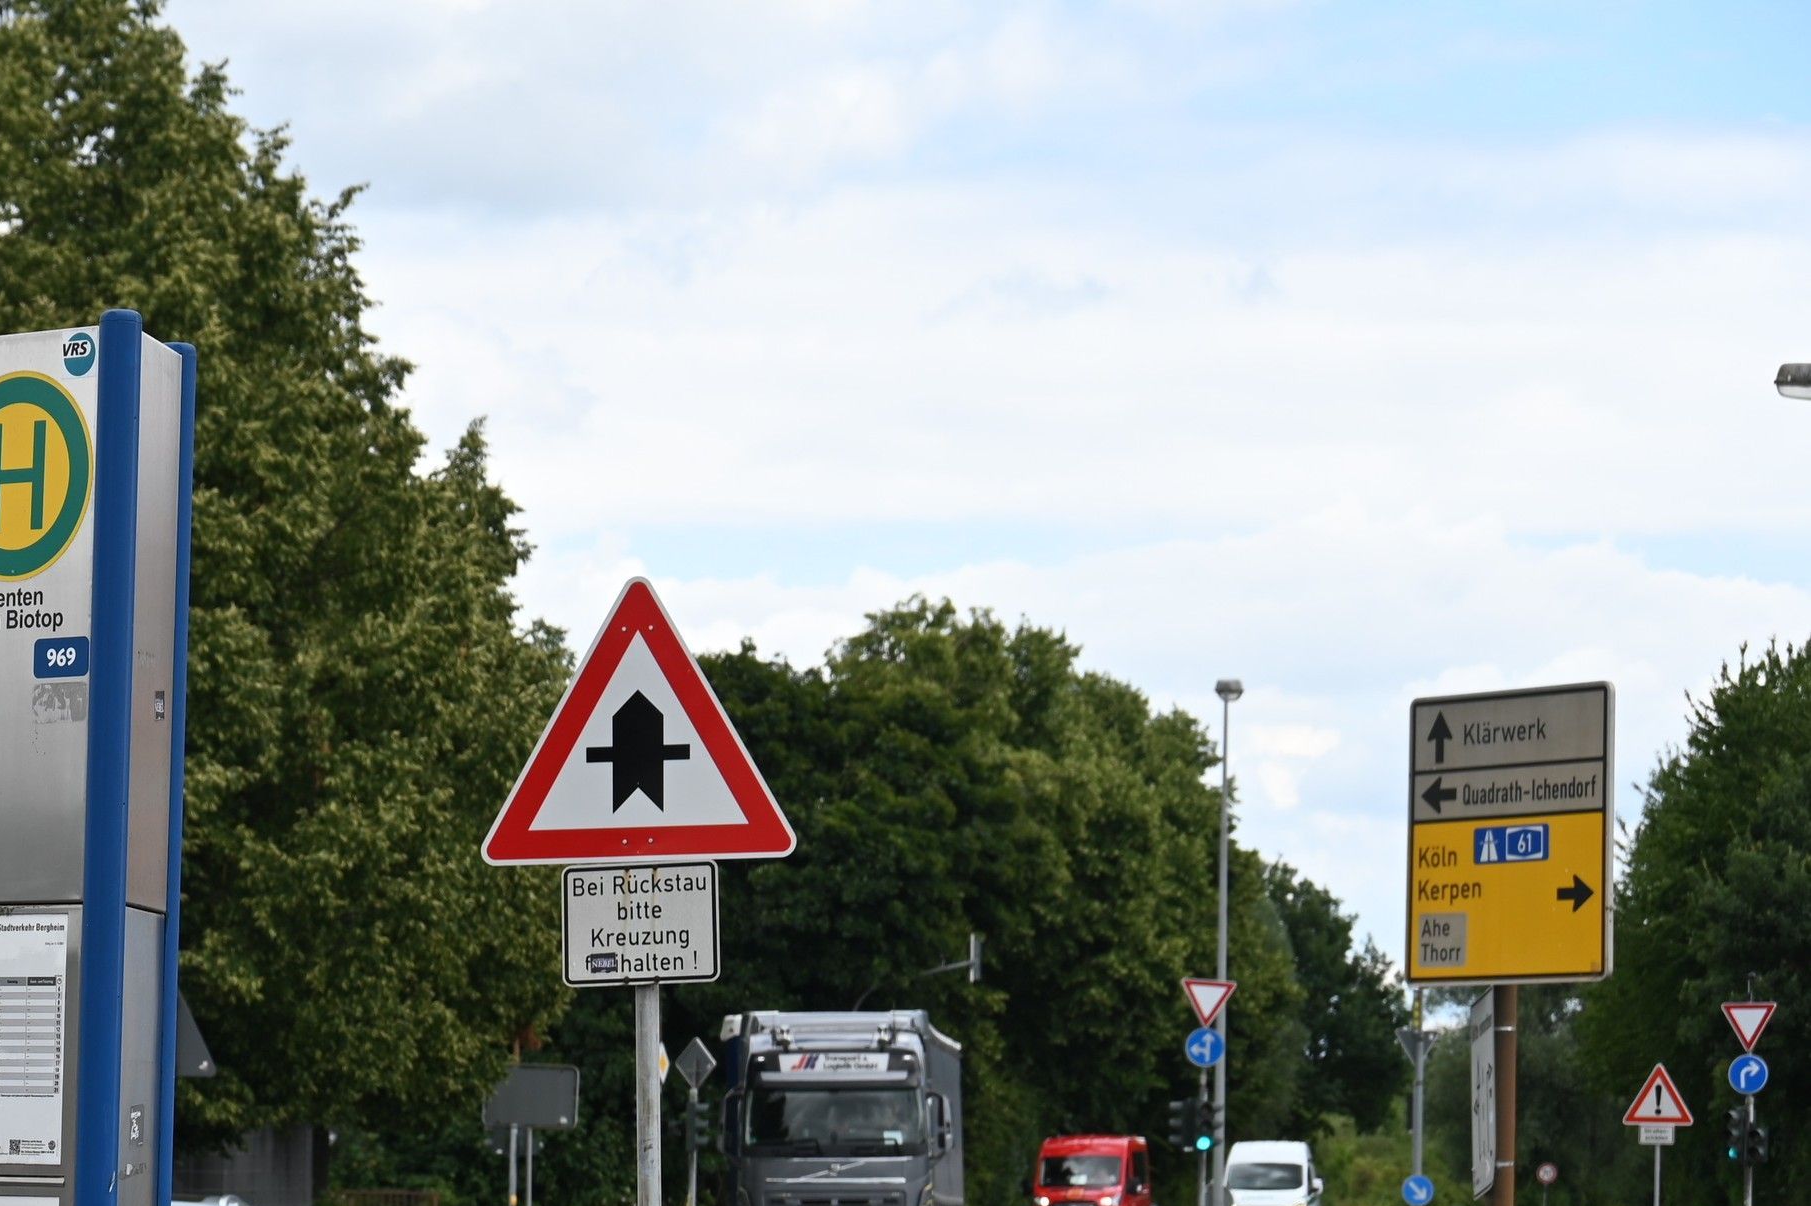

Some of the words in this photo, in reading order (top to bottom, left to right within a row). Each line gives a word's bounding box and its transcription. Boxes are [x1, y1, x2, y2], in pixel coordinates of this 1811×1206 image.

[62, 341, 88, 357] VRS
[6, 609, 64, 632] Biotop
[46, 647, 77, 668] 969
[1463, 718, 1547, 746] Klärwerk
[1463, 775, 1598, 806] Quadrath-Ichendorf
[1517, 832, 1533, 854] 61
[1418, 846, 1457, 869] Köln
[572, 876, 604, 897] Bei
[613, 874, 707, 895] Rückstau
[1418, 879, 1482, 905] Kerpen
[617, 901, 662, 921] bitte
[35, 923, 65, 933] Bergheim
[591, 928, 690, 949] Kreuzung
[1421, 919, 1450, 938] Ahe
[585, 952, 684, 973] fihalten
[1420, 943, 1461, 963] Thorr
